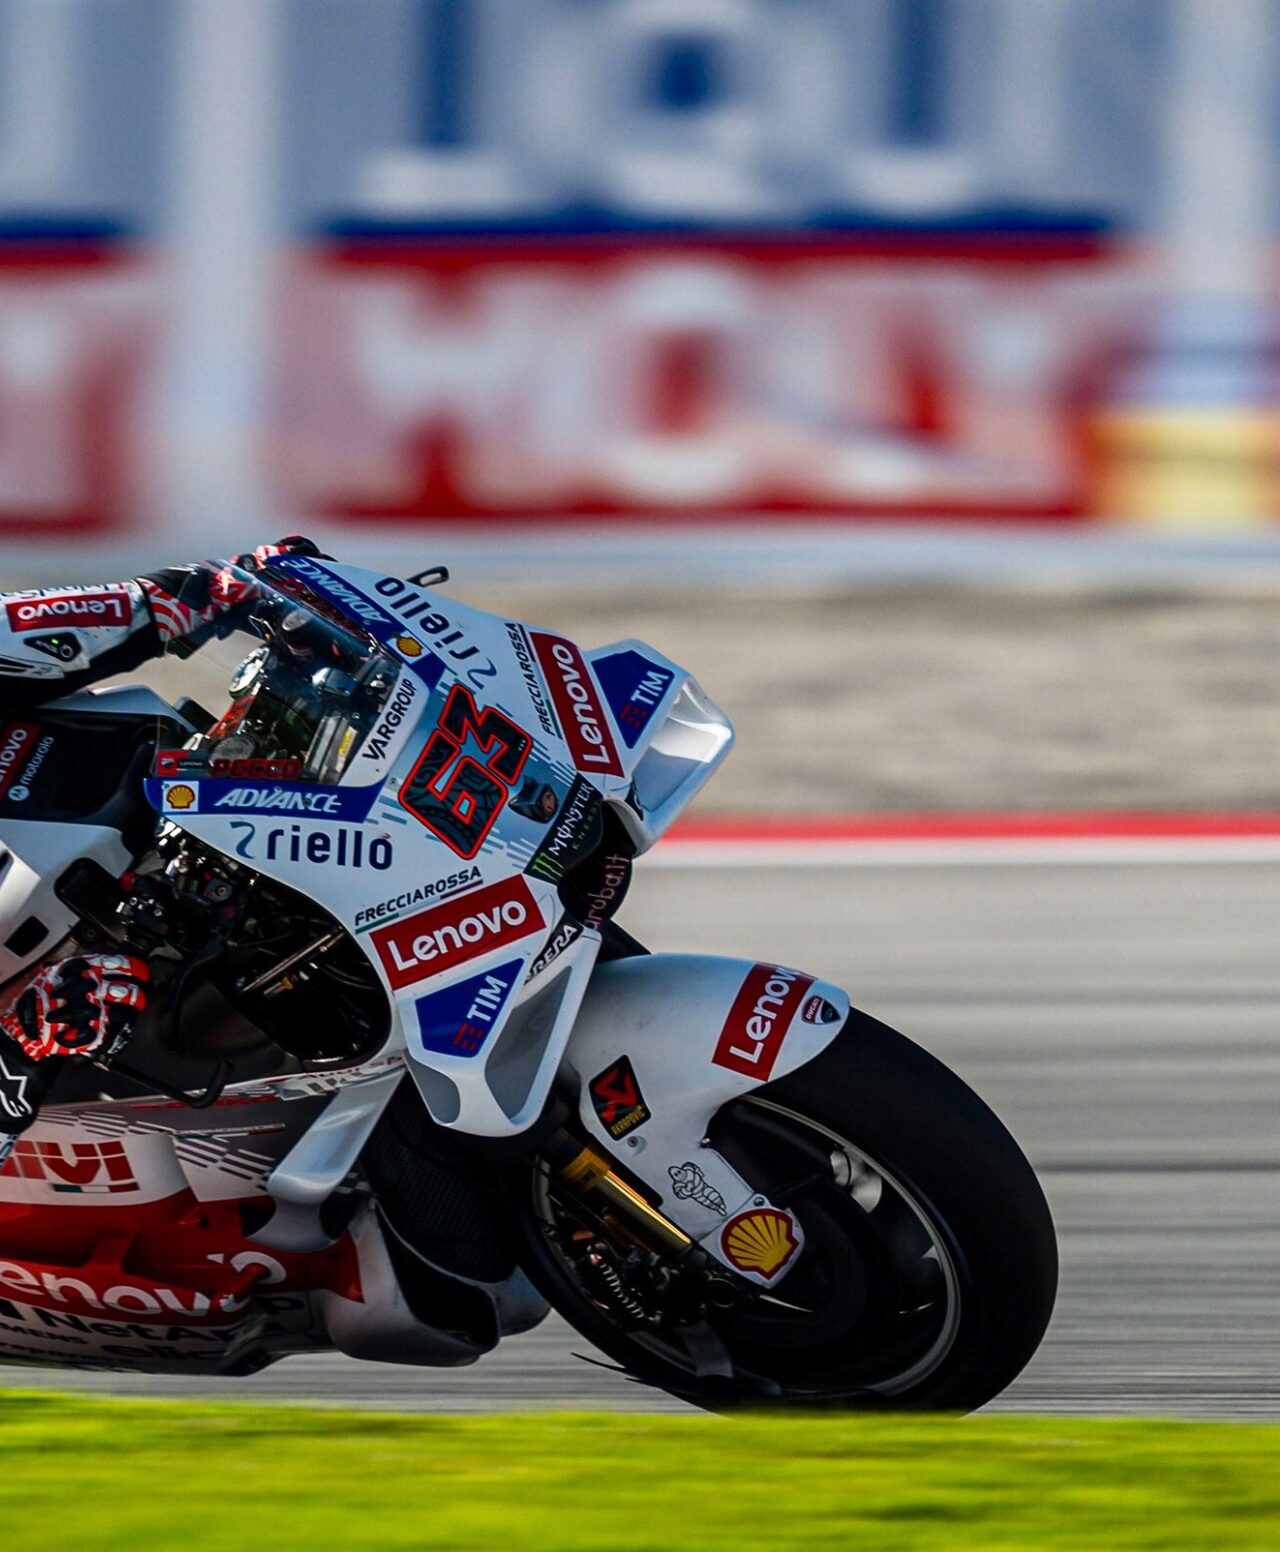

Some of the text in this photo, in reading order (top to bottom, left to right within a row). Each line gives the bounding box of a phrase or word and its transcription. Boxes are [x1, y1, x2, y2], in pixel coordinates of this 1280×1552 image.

[18, 598, 123, 621] Lenovo
[375, 576, 481, 660] riello
[504, 622, 554, 737] FRECCIAROSSA
[551, 643, 609, 765] Lenovo
[630, 670, 669, 708] TIM
[362, 678, 419, 762] VARGROUP
[21, 736, 56, 786] motorola
[398, 682, 534, 860] 63
[214, 787, 342, 814] ADVANCE
[267, 825, 394, 871] riello
[355, 865, 483, 927] FRECCIAROSSA
[386, 900, 527, 972] Lenovo
[467, 974, 508, 1023] TIM
[728, 966, 797, 1064] Lenov
